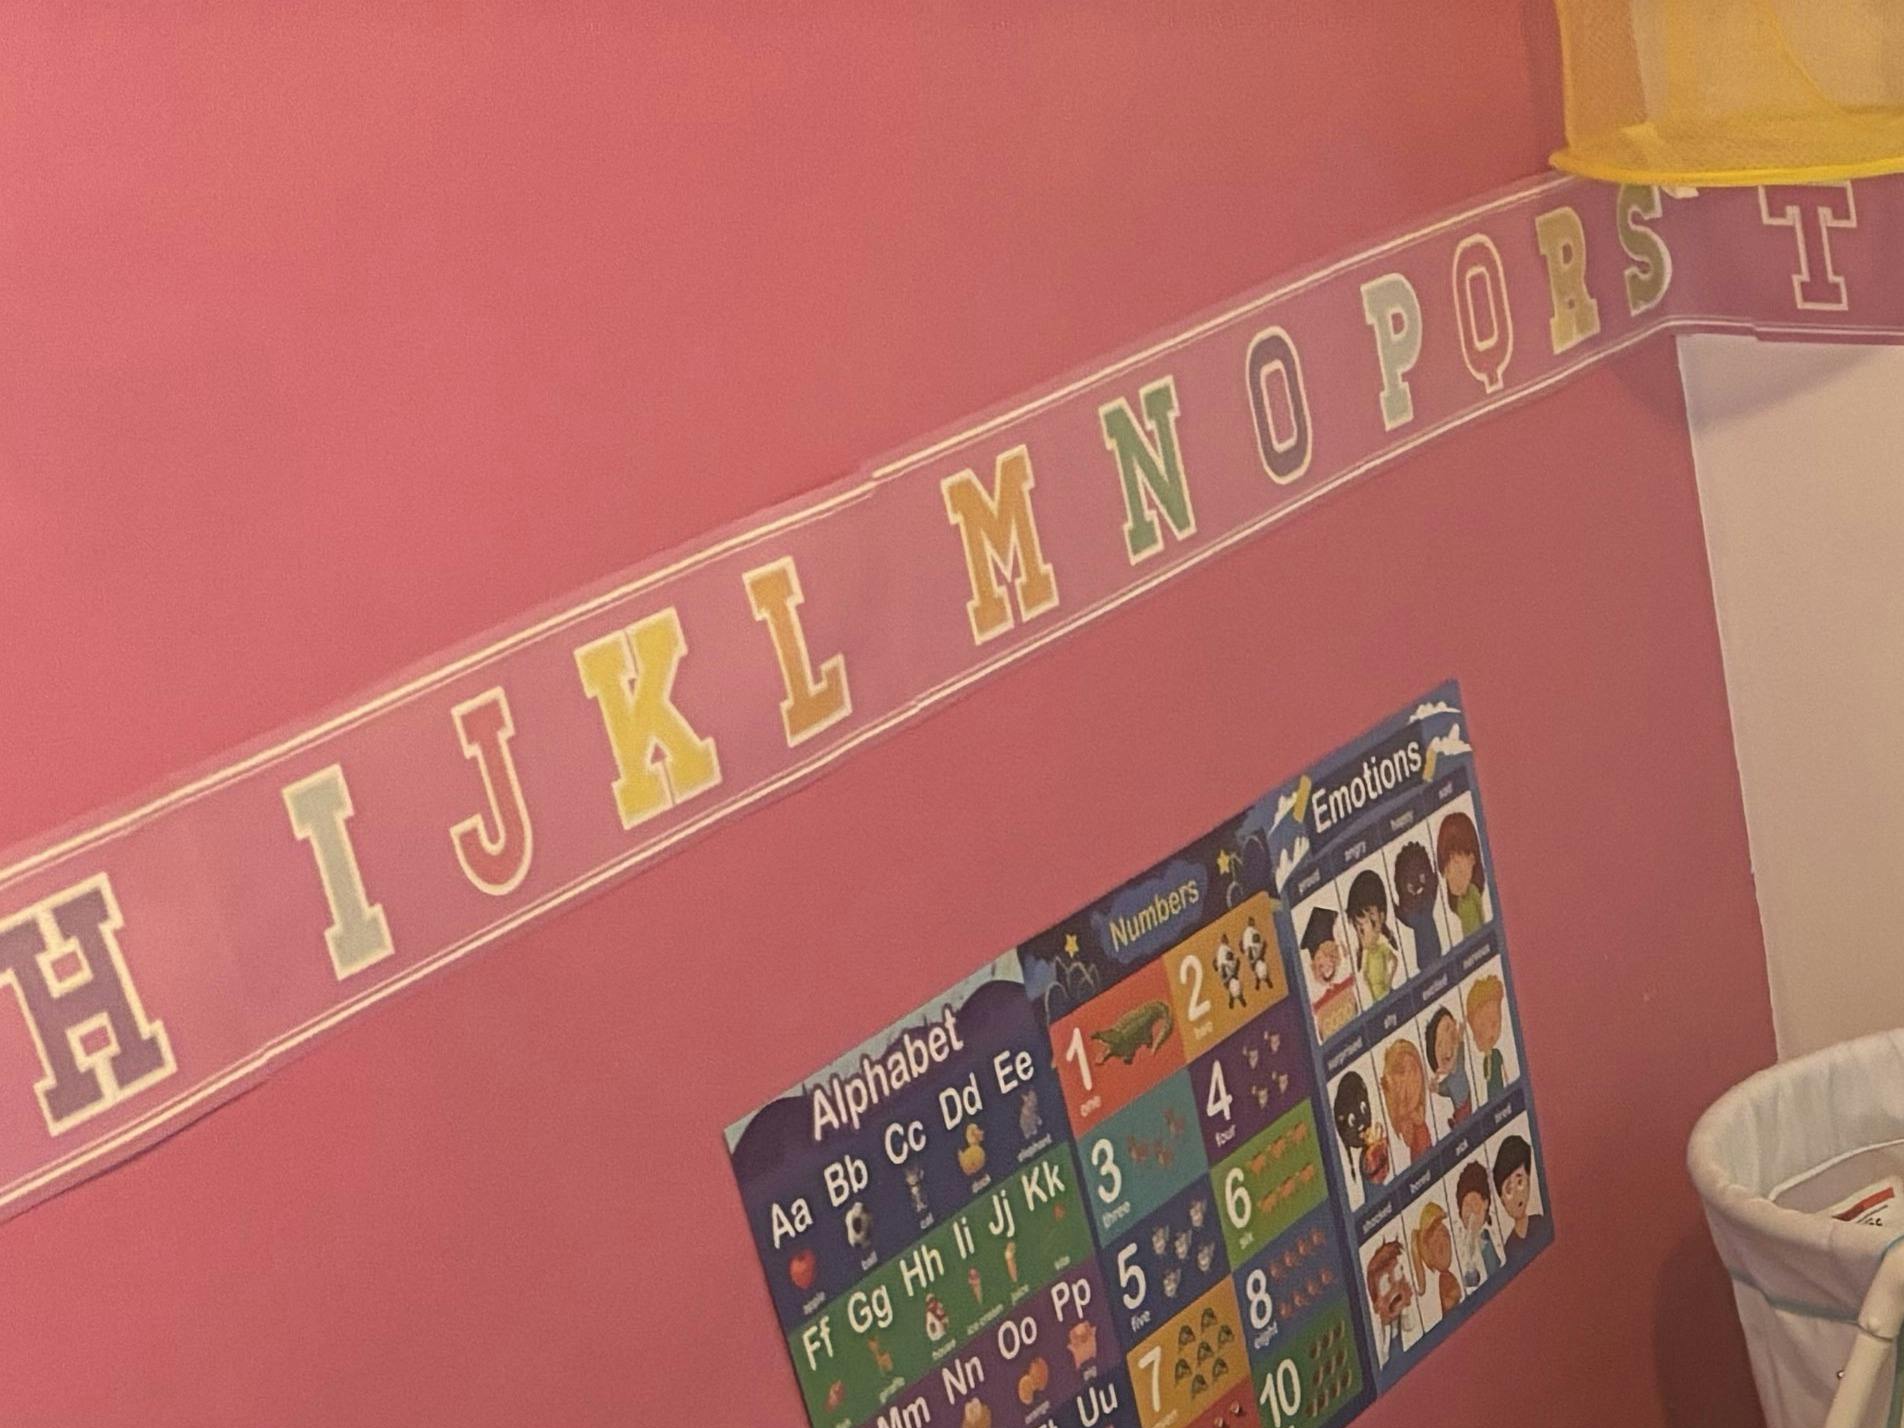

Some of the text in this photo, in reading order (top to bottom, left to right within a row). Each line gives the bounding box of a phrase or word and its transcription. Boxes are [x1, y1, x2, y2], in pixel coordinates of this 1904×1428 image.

[0, 872, 177, 1136] H
[282, 764, 395, 980] I
[450, 686, 534, 896] J
[574, 607, 723, 830] K
[744, 556, 854, 747] L
[941, 446, 1059, 645] M
[1099, 376, 1196, 565] N
[1245, 326, 1313, 485] O
[1360, 273, 1423, 432] P
[1452, 233, 1513, 394] Q
[1535, 206, 1601, 355] R
[1616, 185, 1673, 316] S
[1758, 183, 1856, 311] T
[1311, 740, 1422, 834] Emotions
[1109, 879, 1200, 952] Numbers
[1179, 955, 1211, 1022] 2
[812, 1006, 964, 1142] Alphabet
[1066, 1027, 1092, 1091] 1
[1206, 1060, 1233, 1121] 4
[769, 1049, 1034, 1249] Aa Bb Cc Dd Ee
[1092, 1142, 1122, 1203] 3
[1225, 1167, 1251, 1229] 6
[802, 1316, 834, 1371] Ff
[847, 1284, 894, 1334] Gg
[900, 1245, 944, 1297] Hh
[954, 1216, 974, 1260] Ii
[988, 1190, 1015, 1239] Jj
[1021, 1162, 1065, 1212] Kk
[1117, 1242, 1146, 1310] 5
[1246, 1269, 1273, 1330] 8
[941, 1355, 984, 1405] Nn
[997, 1316, 1038, 1360] Oo
[1051, 1277, 1092, 1323] Pp
[1131, 1310, 1151, 1333] five
[1076, 1383, 1118, 1428] Uu
[1138, 1345, 1162, 1413] 7
